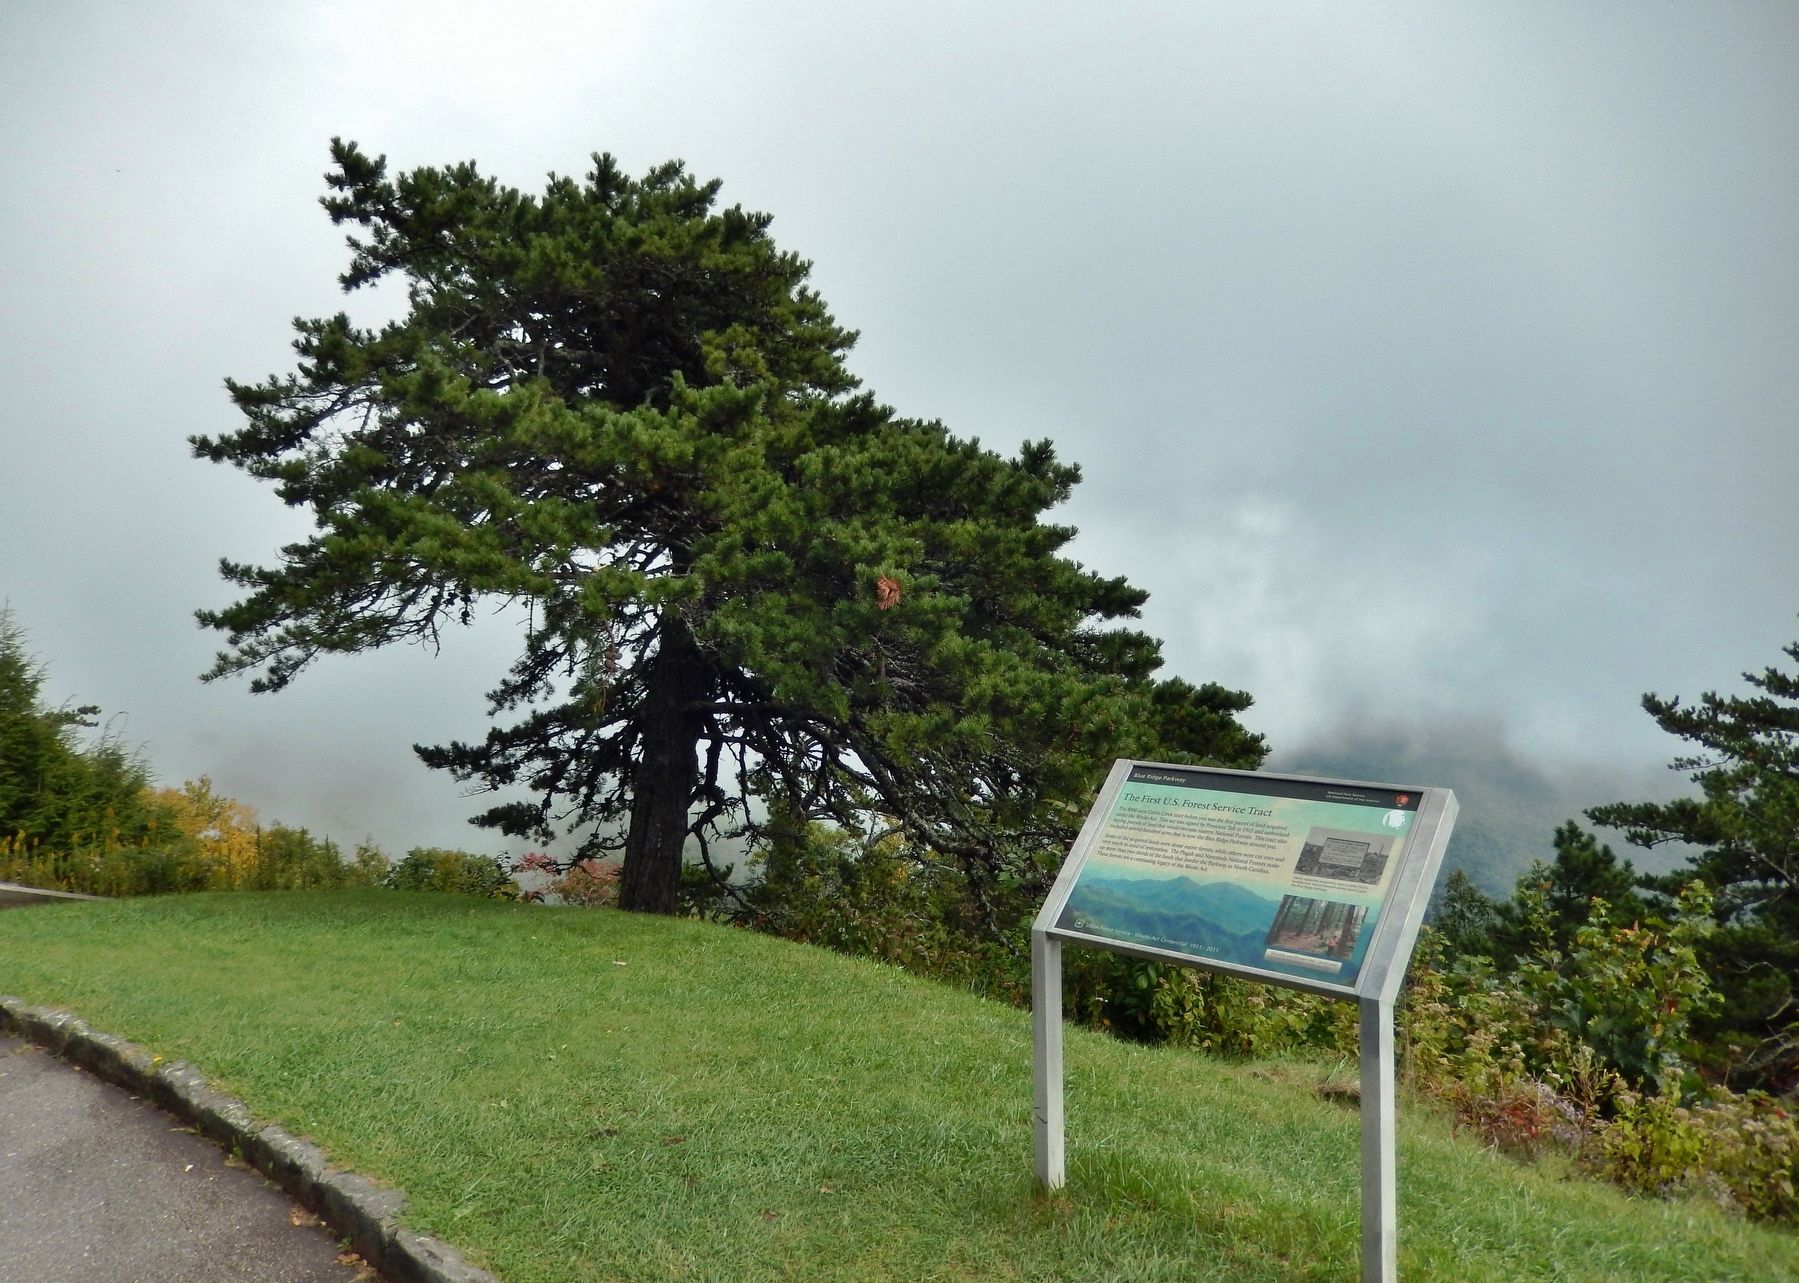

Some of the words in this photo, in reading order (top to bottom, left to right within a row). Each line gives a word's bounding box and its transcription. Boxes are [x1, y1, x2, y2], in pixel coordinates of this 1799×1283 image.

[1123, 792, 1140, 801] The
[1141, 794, 1162, 804] First
[1162, 797, 1180, 806] U.S.
[1182, 799, 1210, 809] Forest
[1210, 802, 1246, 813] Service
[1249, 806, 1273, 816] Tract
